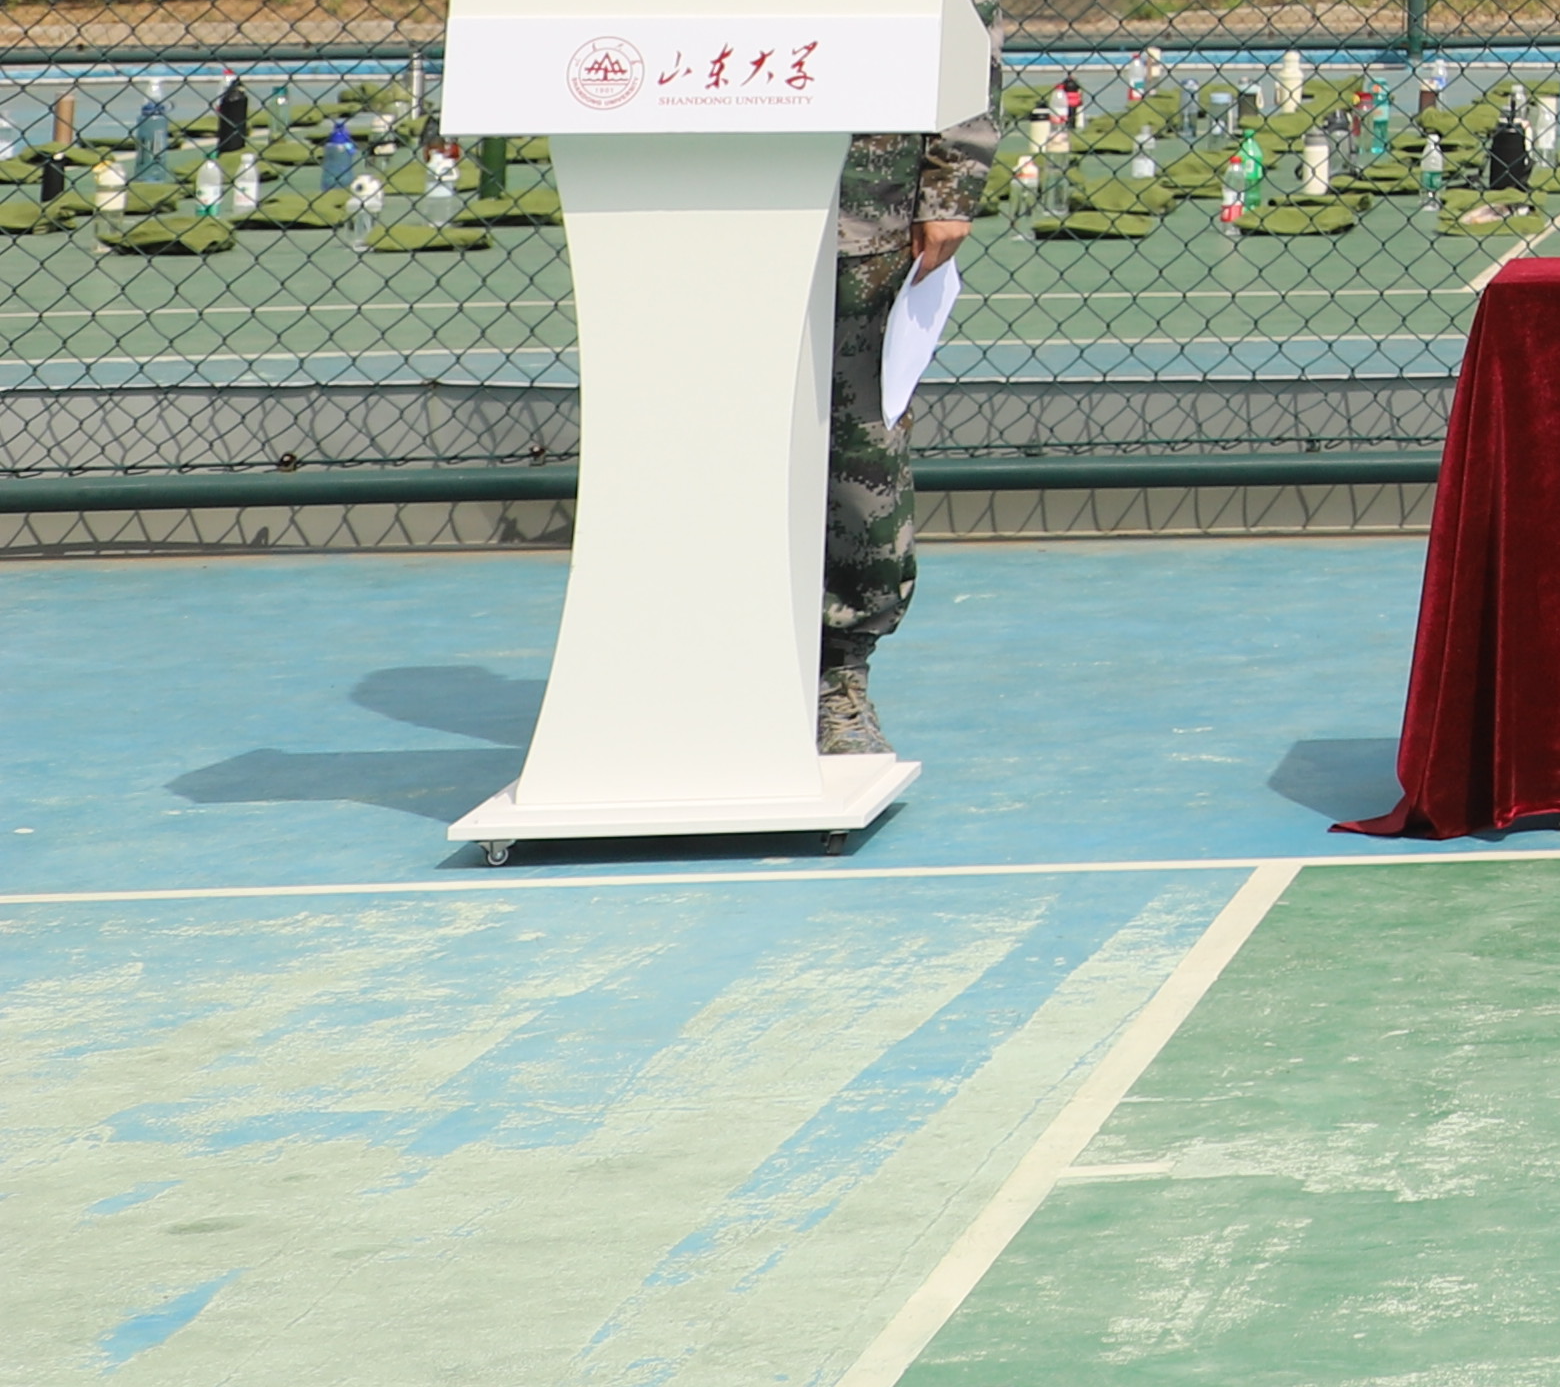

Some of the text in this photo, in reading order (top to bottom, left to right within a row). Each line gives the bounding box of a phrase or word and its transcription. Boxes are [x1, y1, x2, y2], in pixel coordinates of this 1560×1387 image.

[658, 40, 818, 90] 山东大学
[658, 96, 815, 106] SHANDONG UNIVERSITY
